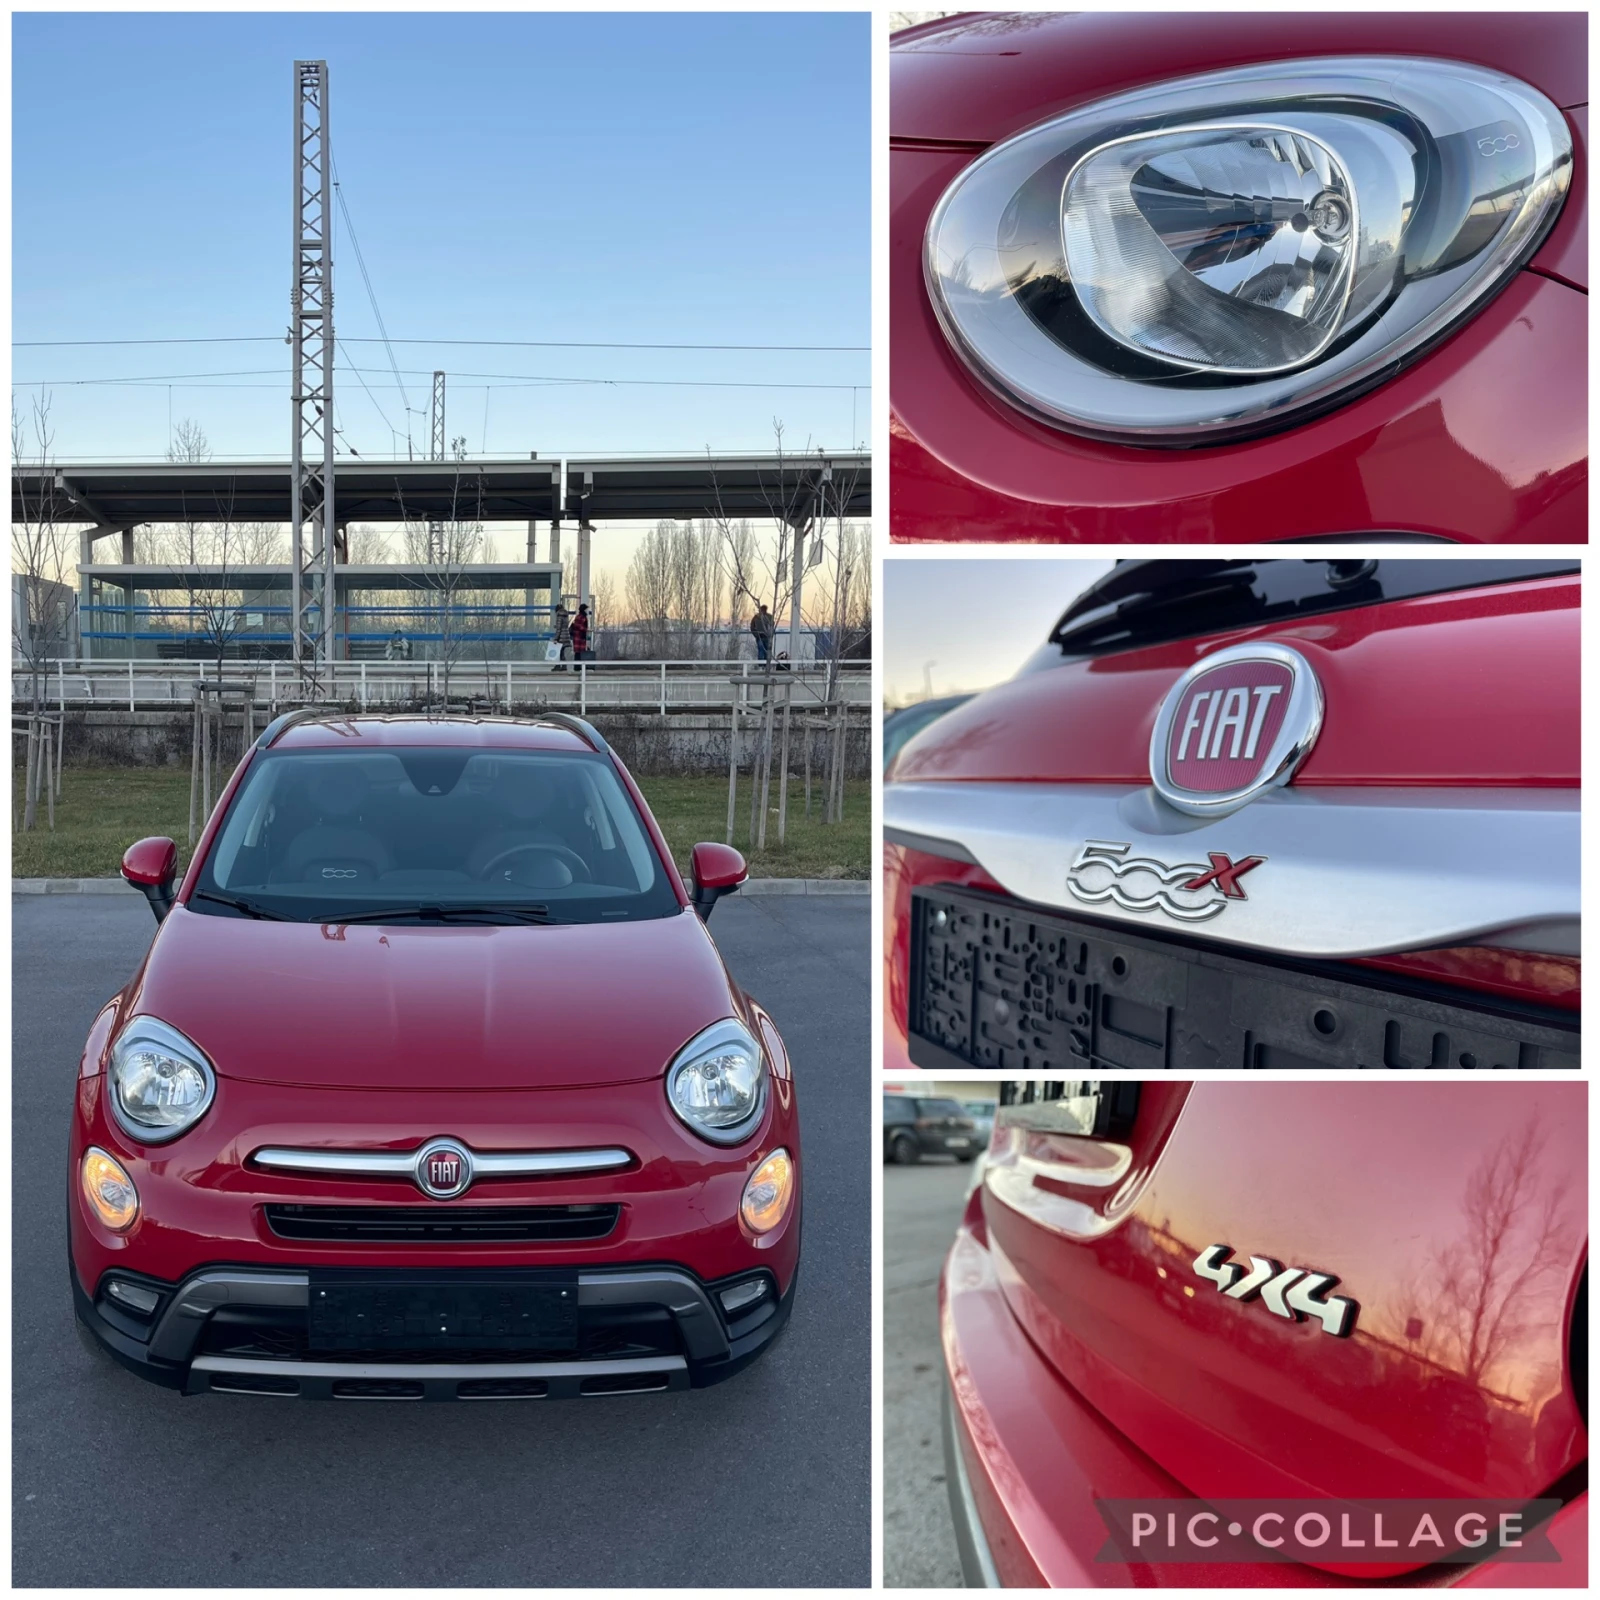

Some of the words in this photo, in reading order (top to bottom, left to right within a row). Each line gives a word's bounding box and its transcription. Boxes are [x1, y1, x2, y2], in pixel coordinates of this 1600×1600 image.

[1477, 134, 1520, 157] 500
[1177, 685, 1283, 761] FIAT
[322, 867, 358, 879] 500
[431, 1161, 459, 1183] FIAT
